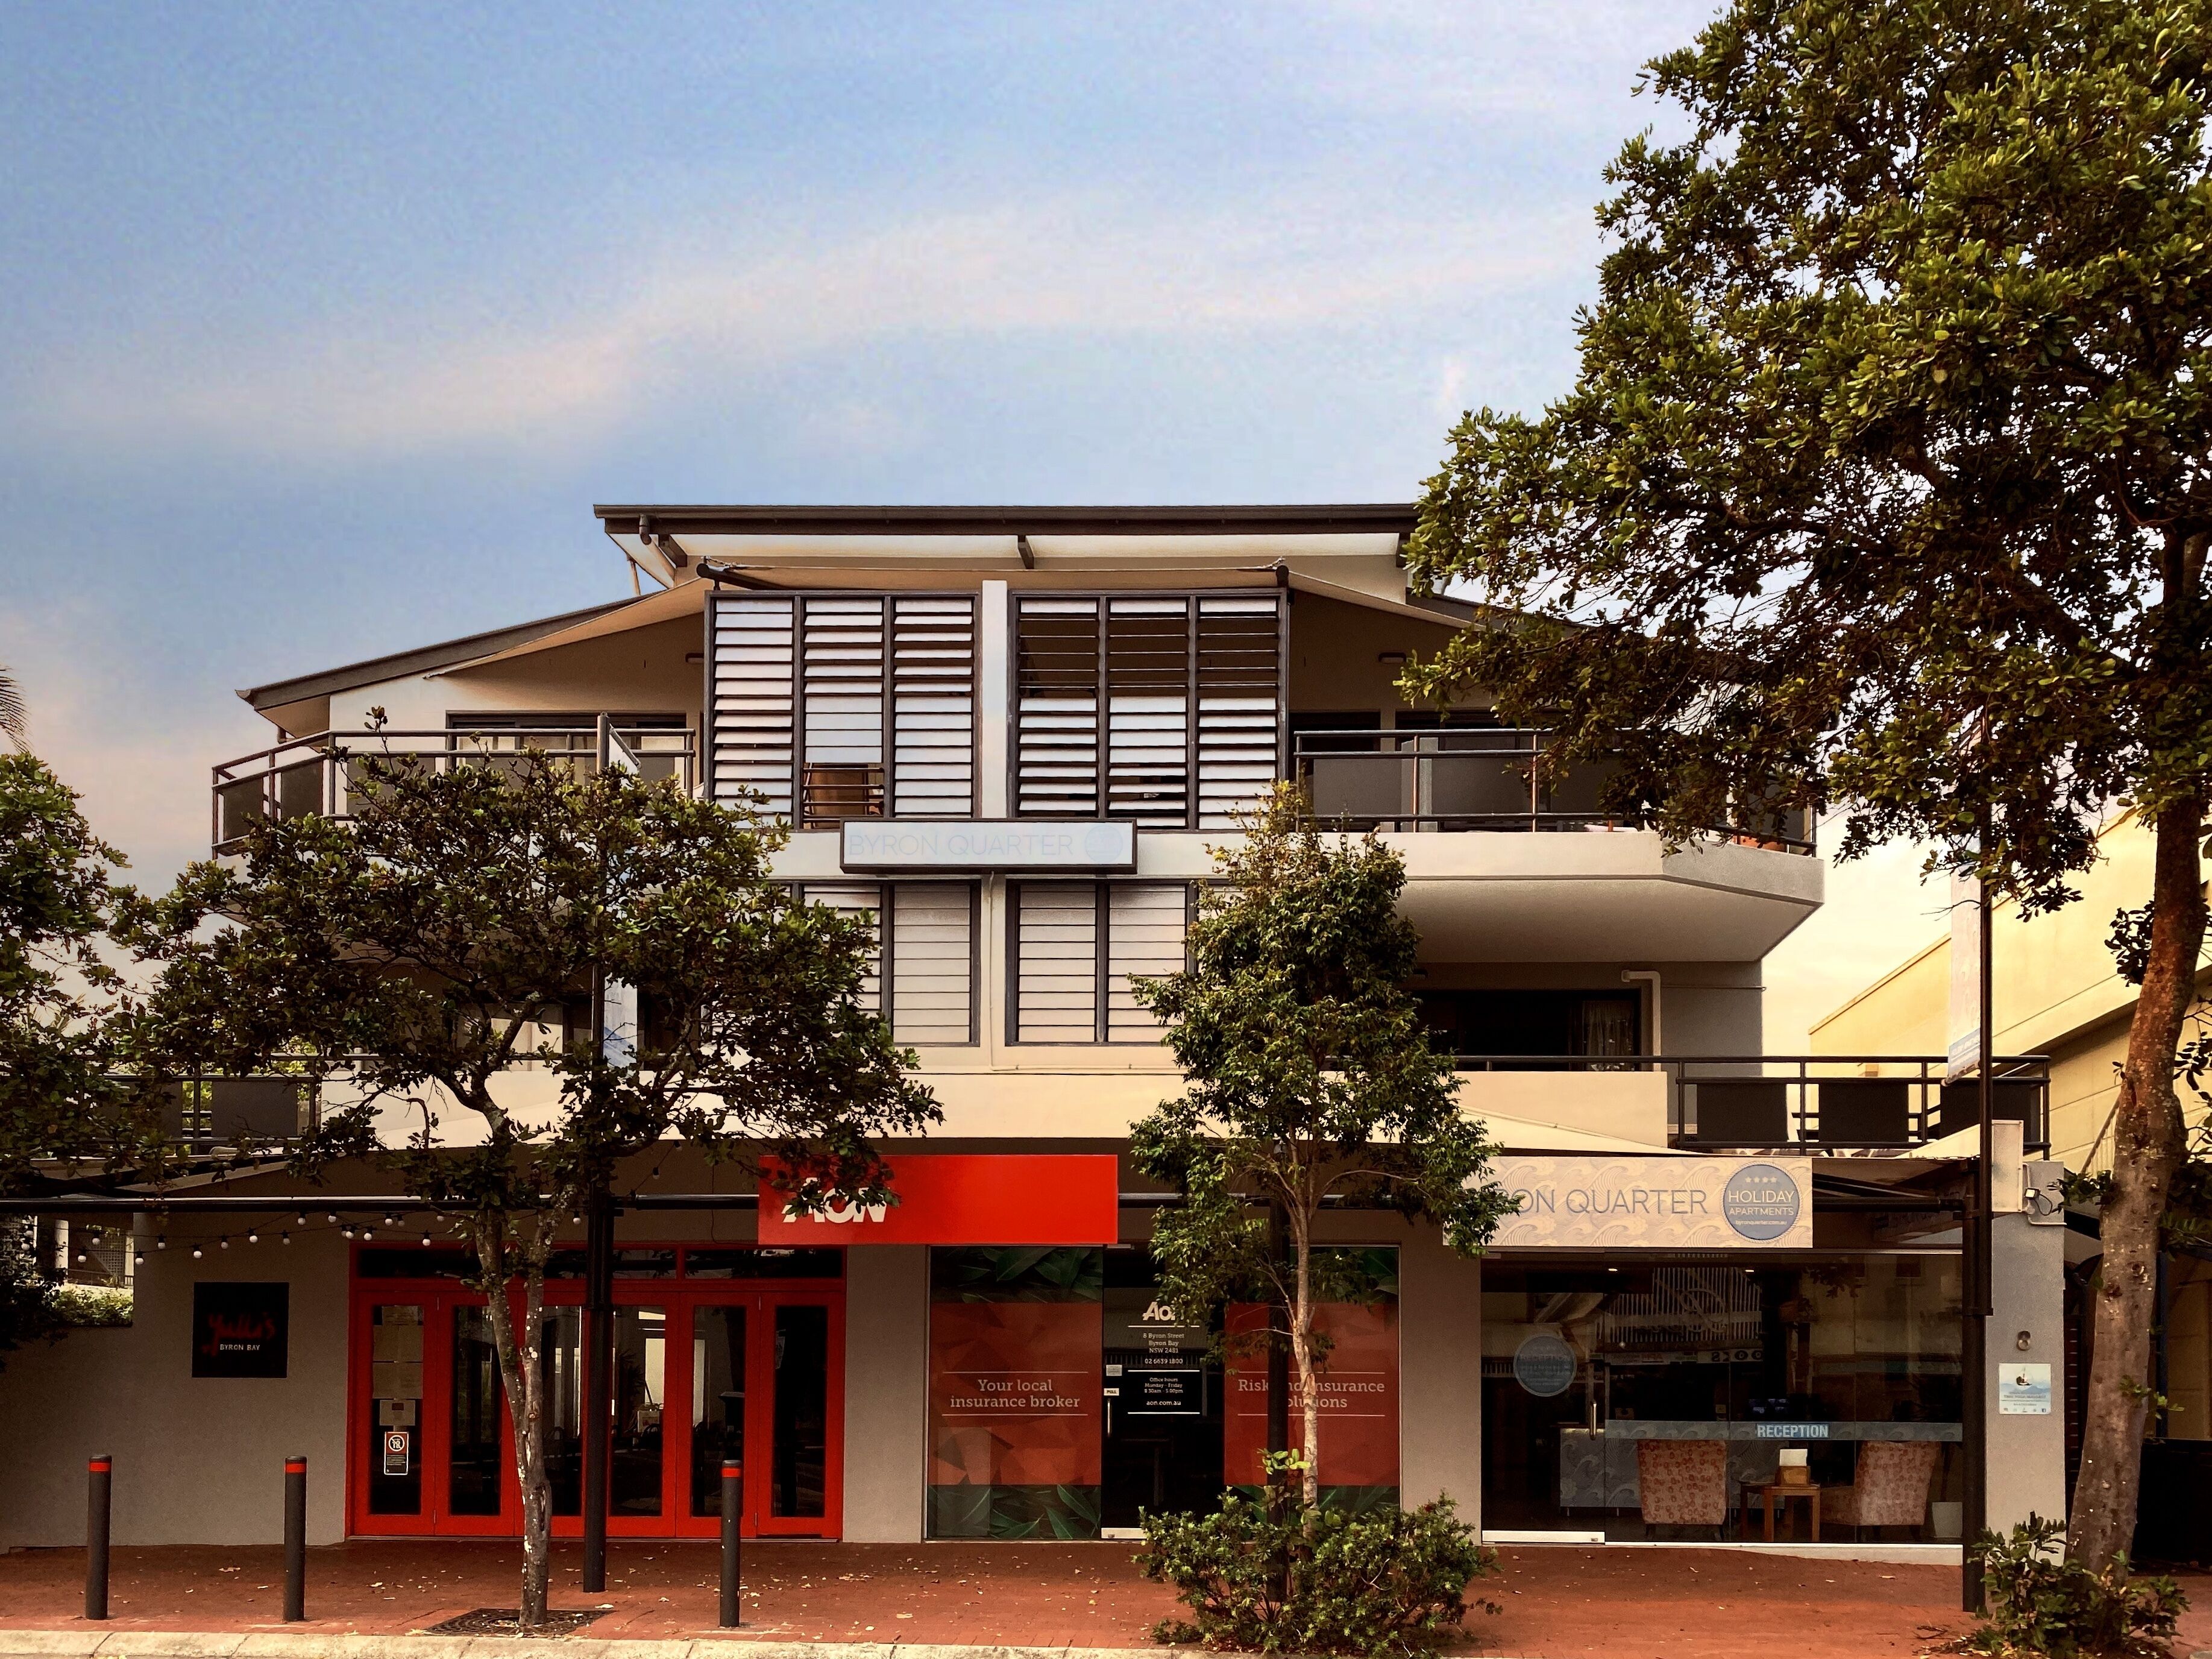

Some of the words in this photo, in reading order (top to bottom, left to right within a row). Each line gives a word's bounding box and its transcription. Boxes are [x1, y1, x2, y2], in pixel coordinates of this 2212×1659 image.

[849, 834, 938, 855] BYRON
[947, 834, 1074, 855] QUARTER
[1566, 1189, 1708, 1214] QUARTER
[1728, 1190, 1795, 1203] HOLIDAY
[1729, 1207, 1794, 1216] APARTMENTS
[978, 1379, 1013, 1391] Your
[1017, 1379, 1053, 1391] local
[1315, 1382, 1386, 1392] nsurance
[950, 1396, 1026, 1408] insurance
[1030, 1395, 1080, 1408] broker
[1757, 1424, 1829, 1438] RECEPTION
